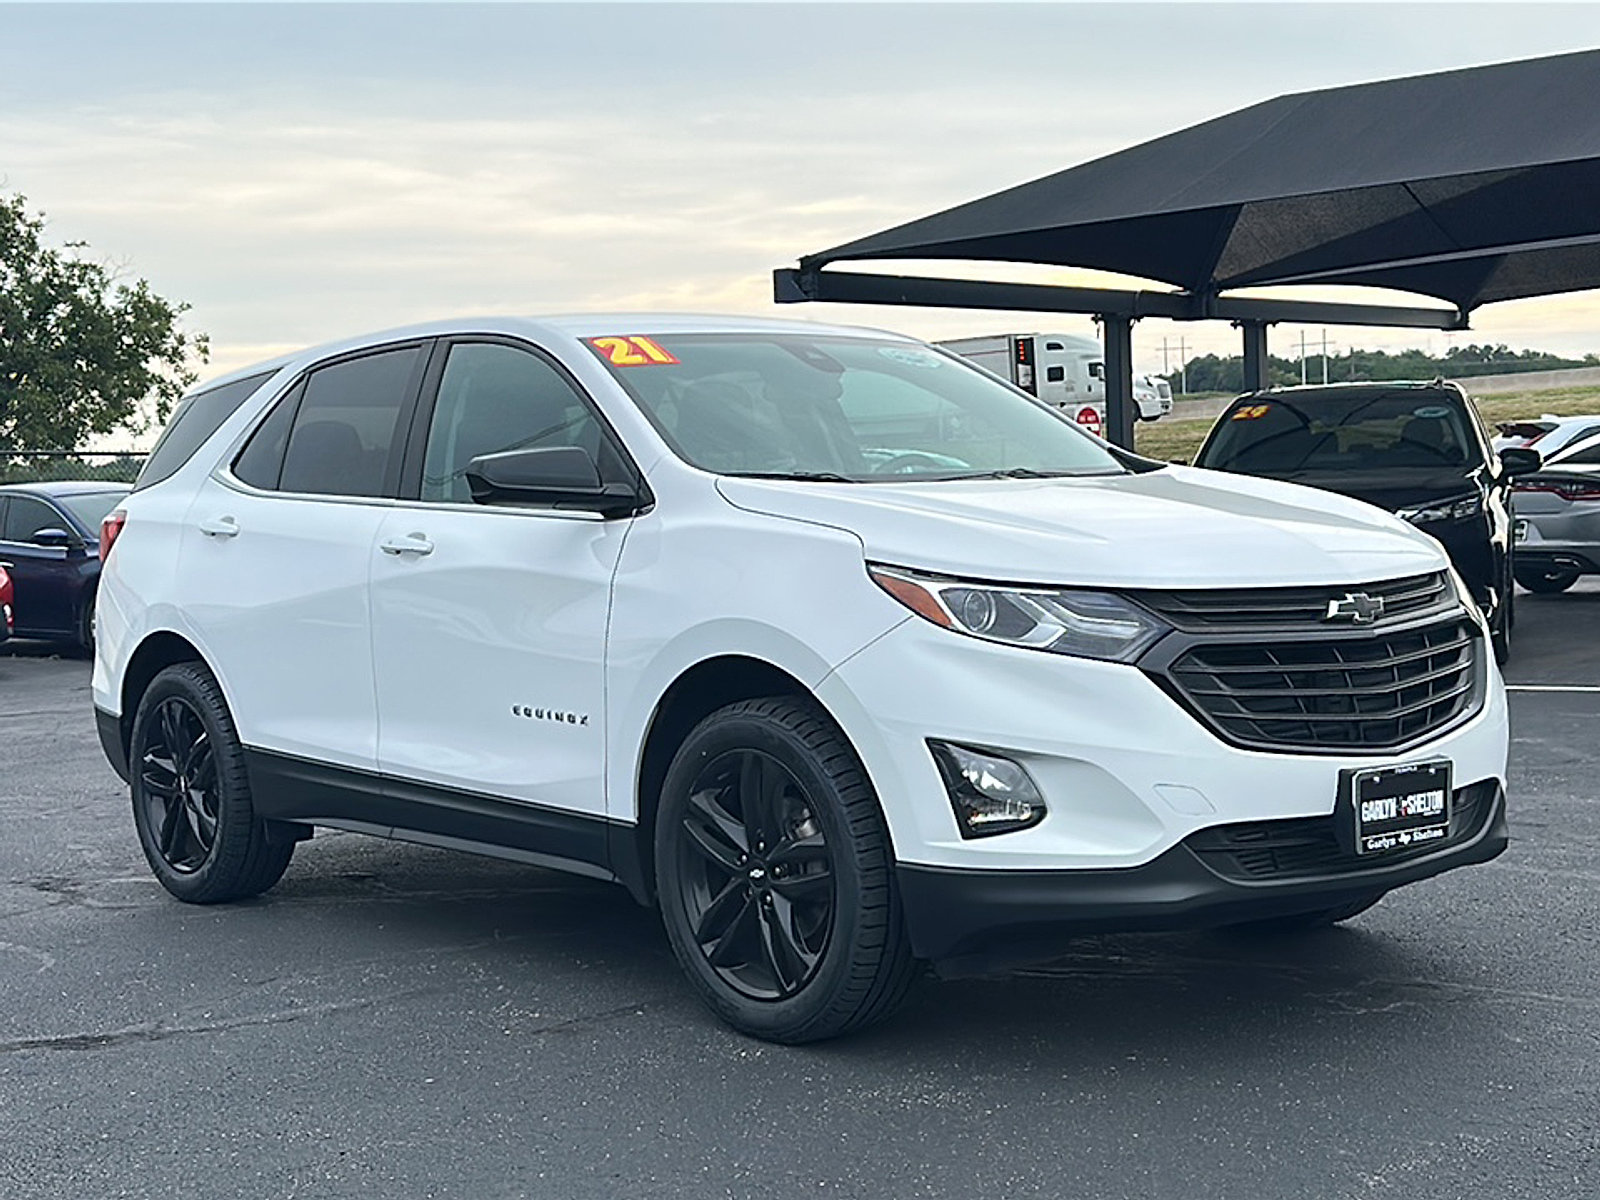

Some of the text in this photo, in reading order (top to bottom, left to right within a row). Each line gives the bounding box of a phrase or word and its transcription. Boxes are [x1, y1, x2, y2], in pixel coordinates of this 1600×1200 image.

[592, 336, 673, 365] 21
[511, 704, 590, 727] EQUINOX
[1406, 789, 1444, 815] SHELTON
